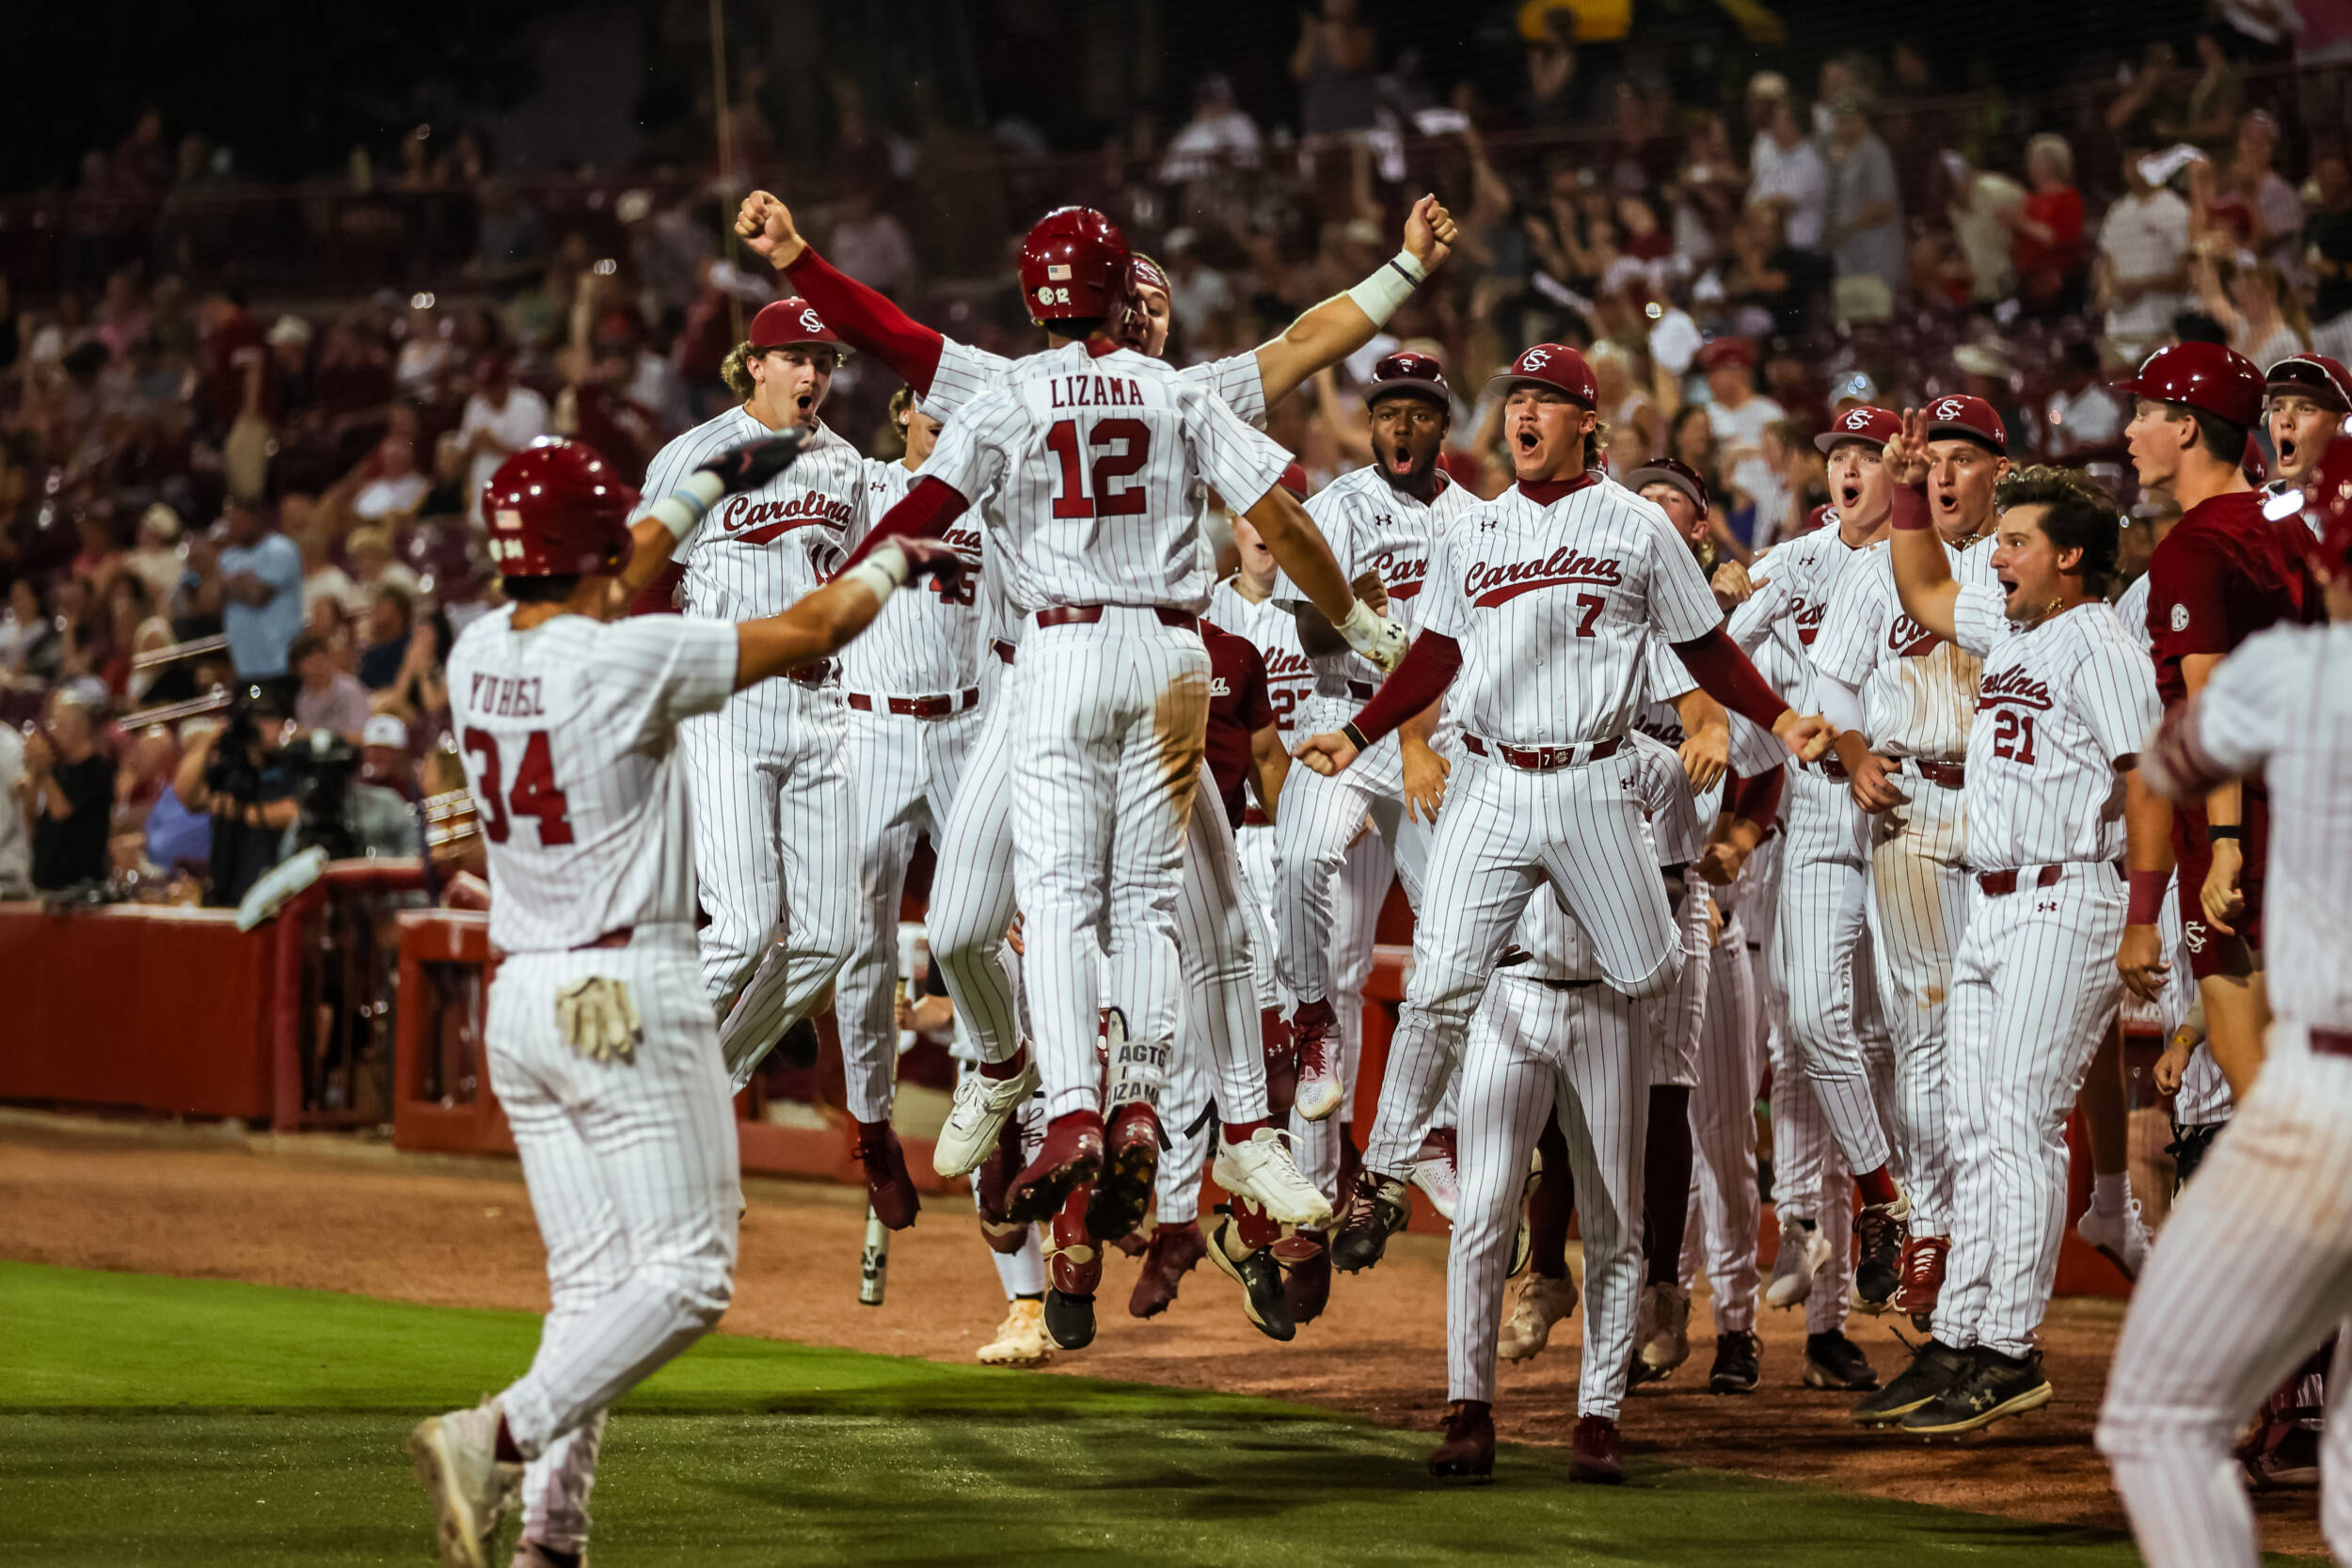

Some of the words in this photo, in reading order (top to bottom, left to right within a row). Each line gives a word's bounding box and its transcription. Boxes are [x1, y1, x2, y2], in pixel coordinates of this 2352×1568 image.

[1056, 287, 1070, 303] 12
[1050, 374, 1145, 408] LIZAMA
[1045, 418, 1152, 519] 12
[723, 490, 852, 532] Carolina
[1465, 546, 1622, 597] Carolina
[1575, 593, 1607, 638] 7
[1544, 753, 1550, 767] 7
[1993, 709, 2036, 766] 21
[464, 724, 576, 846] 34
